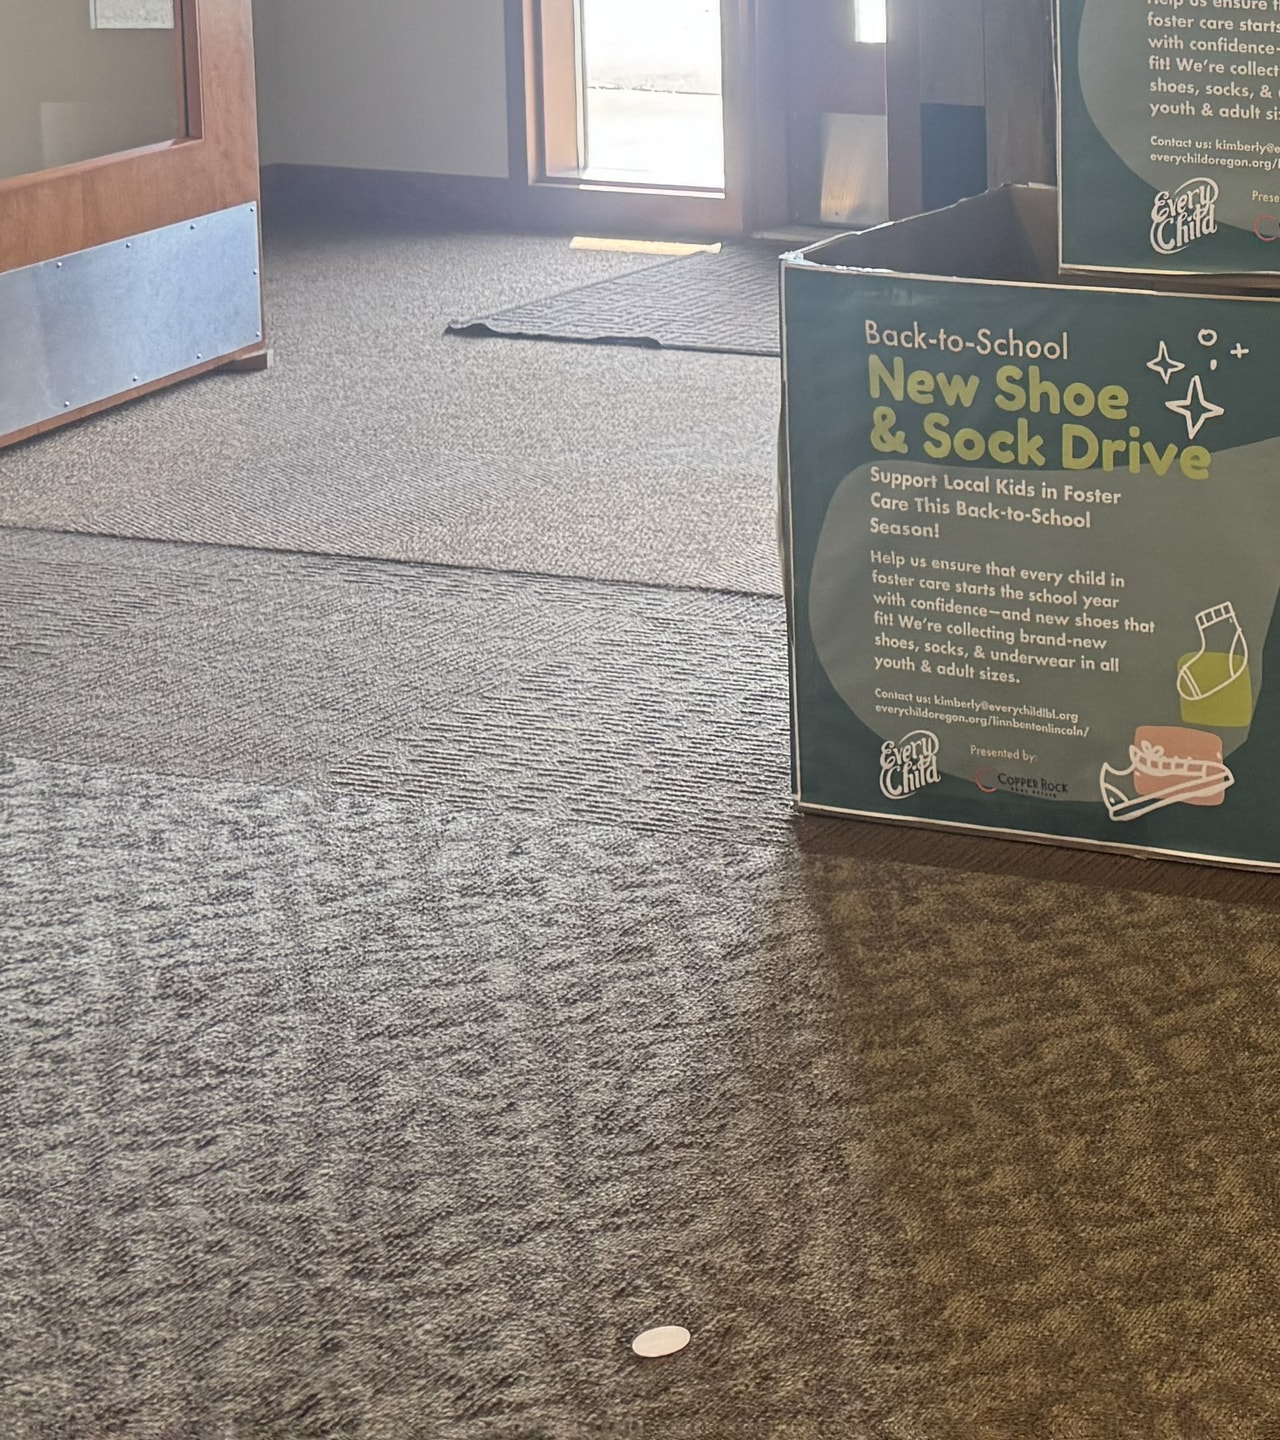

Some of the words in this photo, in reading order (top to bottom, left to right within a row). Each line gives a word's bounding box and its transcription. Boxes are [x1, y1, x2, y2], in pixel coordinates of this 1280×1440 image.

[1149, 76, 1200, 96] shoes,
[1205, 81, 1254, 99] socks,
[1259, 84, 1273, 98] &
[866, 320, 1067, 360] Back-to-School
[867, 355, 980, 407] New
[995, 364, 1128, 421] Shoe
[869, 405, 908, 454] &
[922, 411, 1045, 467] Sock
[1062, 422, 1212, 481] Drive
[869, 467, 939, 490] Support
[944, 473, 989, 493] Local
[995, 478, 1035, 497] Kids
[1041, 481, 1058, 499] in
[1064, 484, 1121, 505] Foster
[870, 517, 939, 539] Season!
